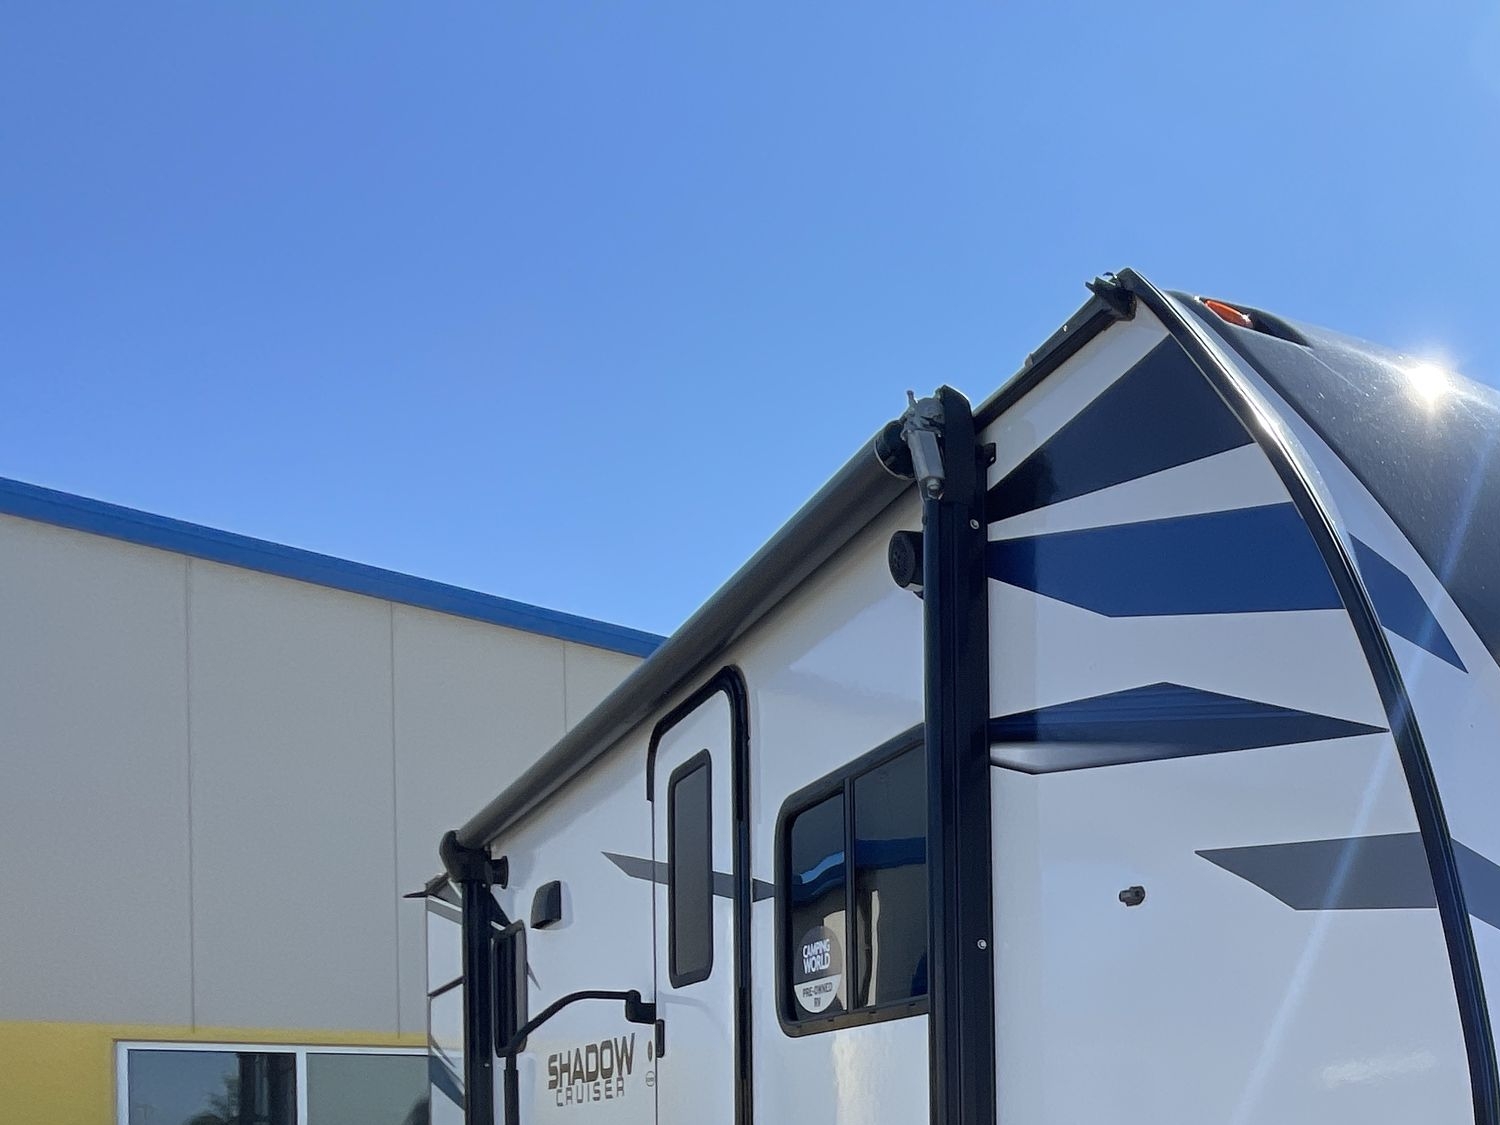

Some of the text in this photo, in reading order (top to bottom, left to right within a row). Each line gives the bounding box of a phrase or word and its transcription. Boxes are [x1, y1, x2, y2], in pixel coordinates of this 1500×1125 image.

[802, 938, 831, 958] CAMPING
[803, 952, 831, 975] WORLD
[548, 1032, 636, 1090] SHADOW
[556, 1075, 625, 1107] CRUISER
